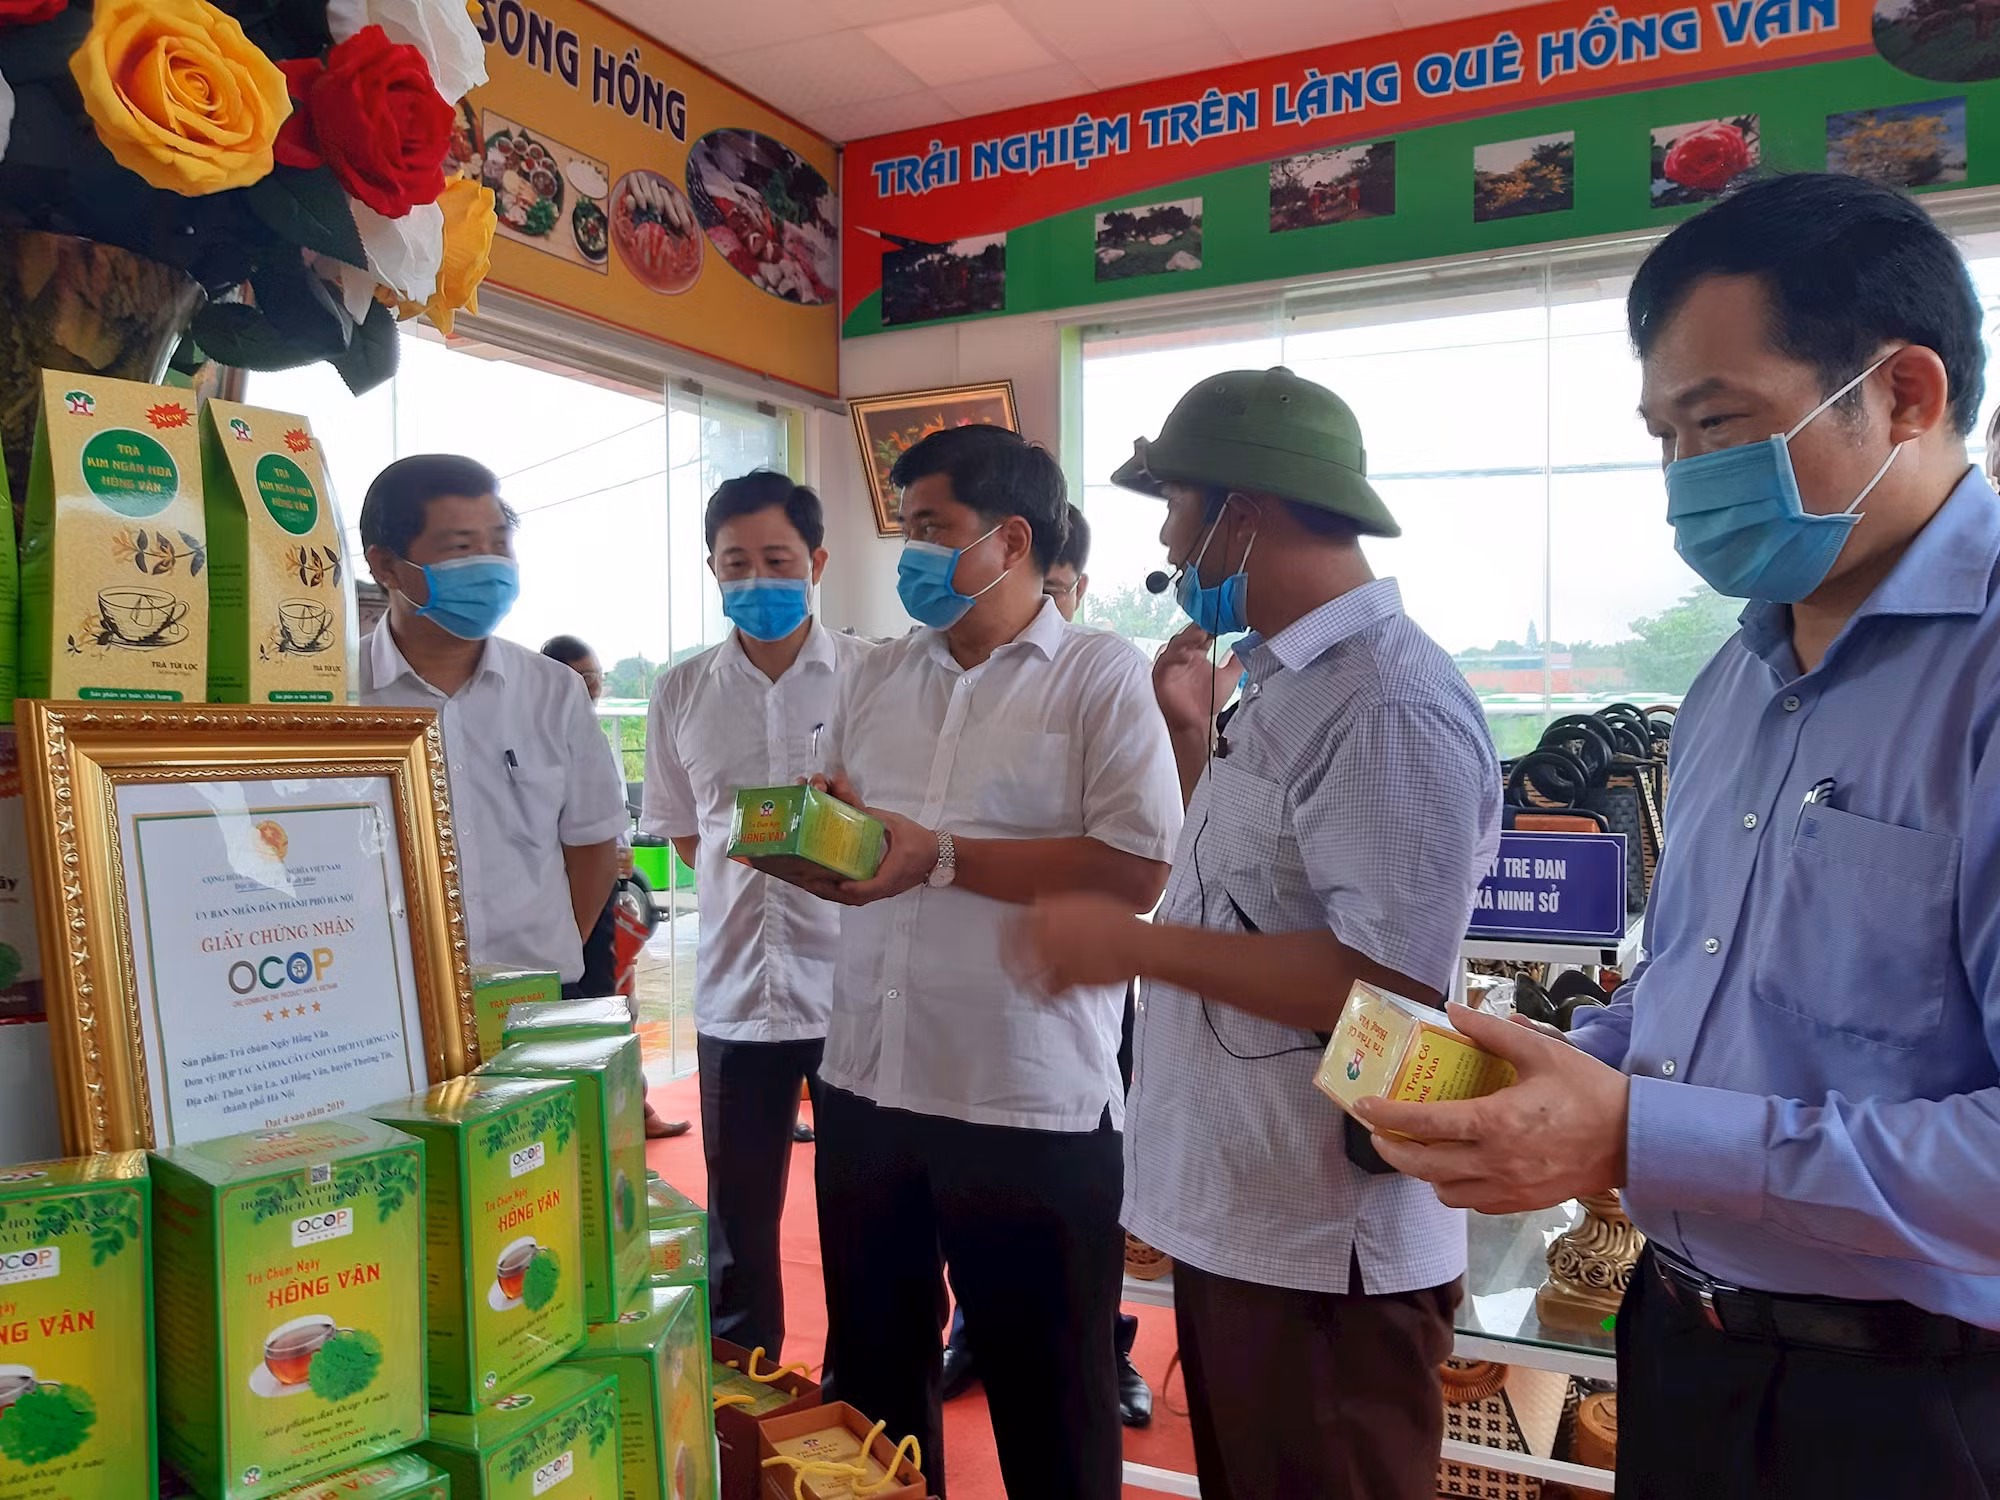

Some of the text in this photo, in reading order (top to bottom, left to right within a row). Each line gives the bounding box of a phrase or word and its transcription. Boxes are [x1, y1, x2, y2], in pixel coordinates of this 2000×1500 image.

[592, 46, 687, 143] HỒNG
[871, 138, 960, 197] TRẢI
[972, 113, 1130, 171] NGHIỆM
[1140, 87, 1259, 147] TRÊN
[1272, 68, 1401, 126] LÀNG
[1414, 31, 1525, 98] QUÊ
[1538, 6, 1701, 85] HỒNG
[154, 412, 183, 424] New
[1504, 858, 1530, 878] TRE
[1534, 859, 1566, 880] ĐAN
[1474, 884, 1560, 913] XÃ NINH SỞ
[201, 915, 356, 953] GIẤY CHỨNG NHẬN
[228, 947, 335, 995] OCOP
[290, 1113, 305, 1121] sao
[327, 1099, 345, 1113] 2019
[512, 1144, 542, 1166] OCOP
[297, 1210, 348, 1233] OCOP
[498, 1189, 561, 1233] HỒNG VÂN
[266, 1263, 381, 1309] HỒNG VÂN
[39, 1308, 96, 1338] VÂN
[537, 1454, 569, 1482] OCOP
